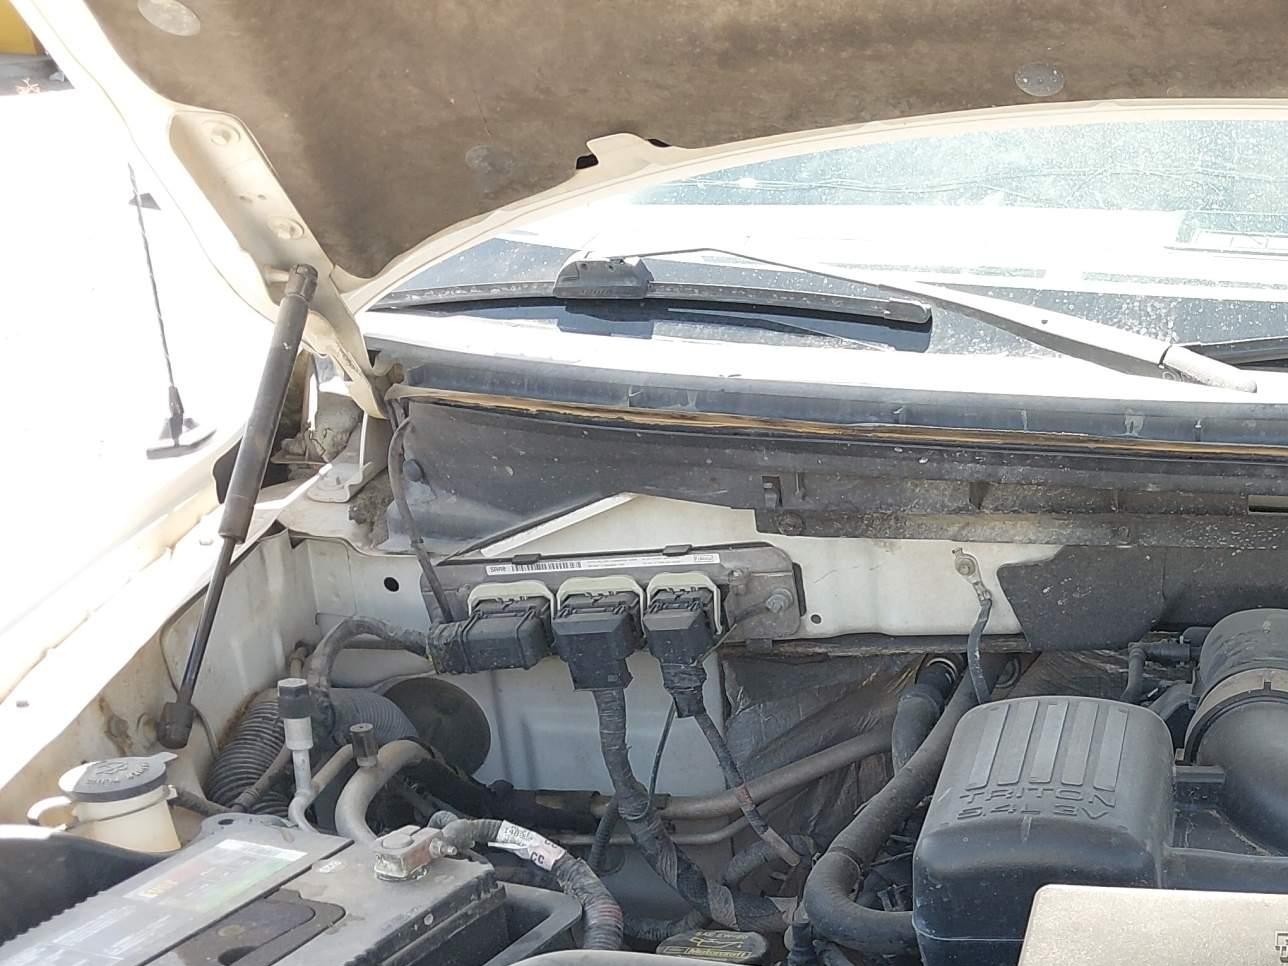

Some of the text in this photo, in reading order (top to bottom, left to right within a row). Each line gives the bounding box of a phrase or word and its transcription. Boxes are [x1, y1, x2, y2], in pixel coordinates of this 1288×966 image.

[959, 786, 1116, 807] TRITON
[956, 803, 1109, 820] 5.4L 3V
